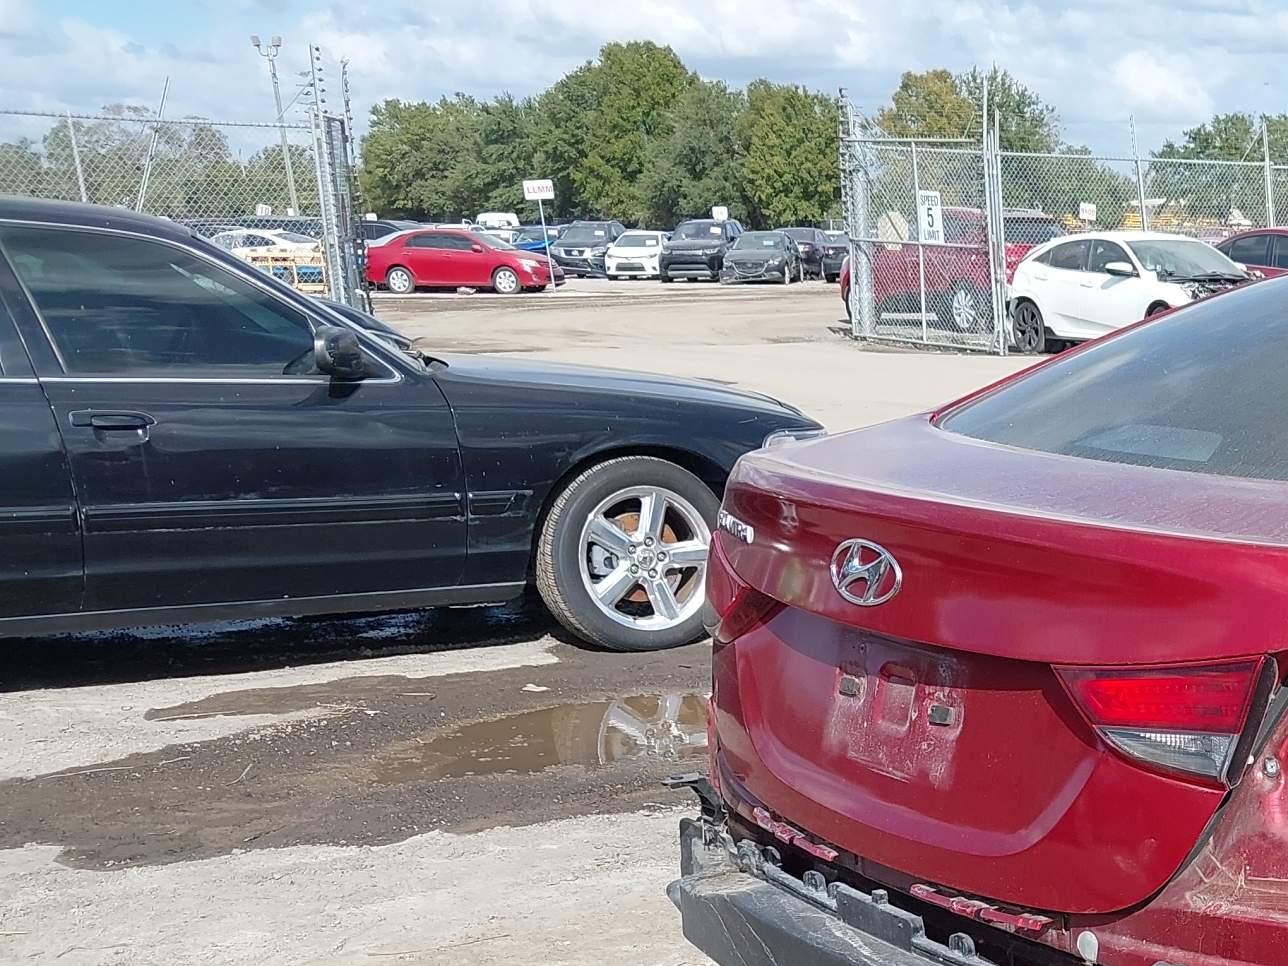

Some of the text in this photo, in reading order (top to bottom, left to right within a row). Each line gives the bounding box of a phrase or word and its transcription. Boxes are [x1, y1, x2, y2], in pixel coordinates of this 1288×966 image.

[920, 195, 938, 206] SPEED
[926, 207, 934, 228] 5
[924, 231, 940, 240] LIMIT
